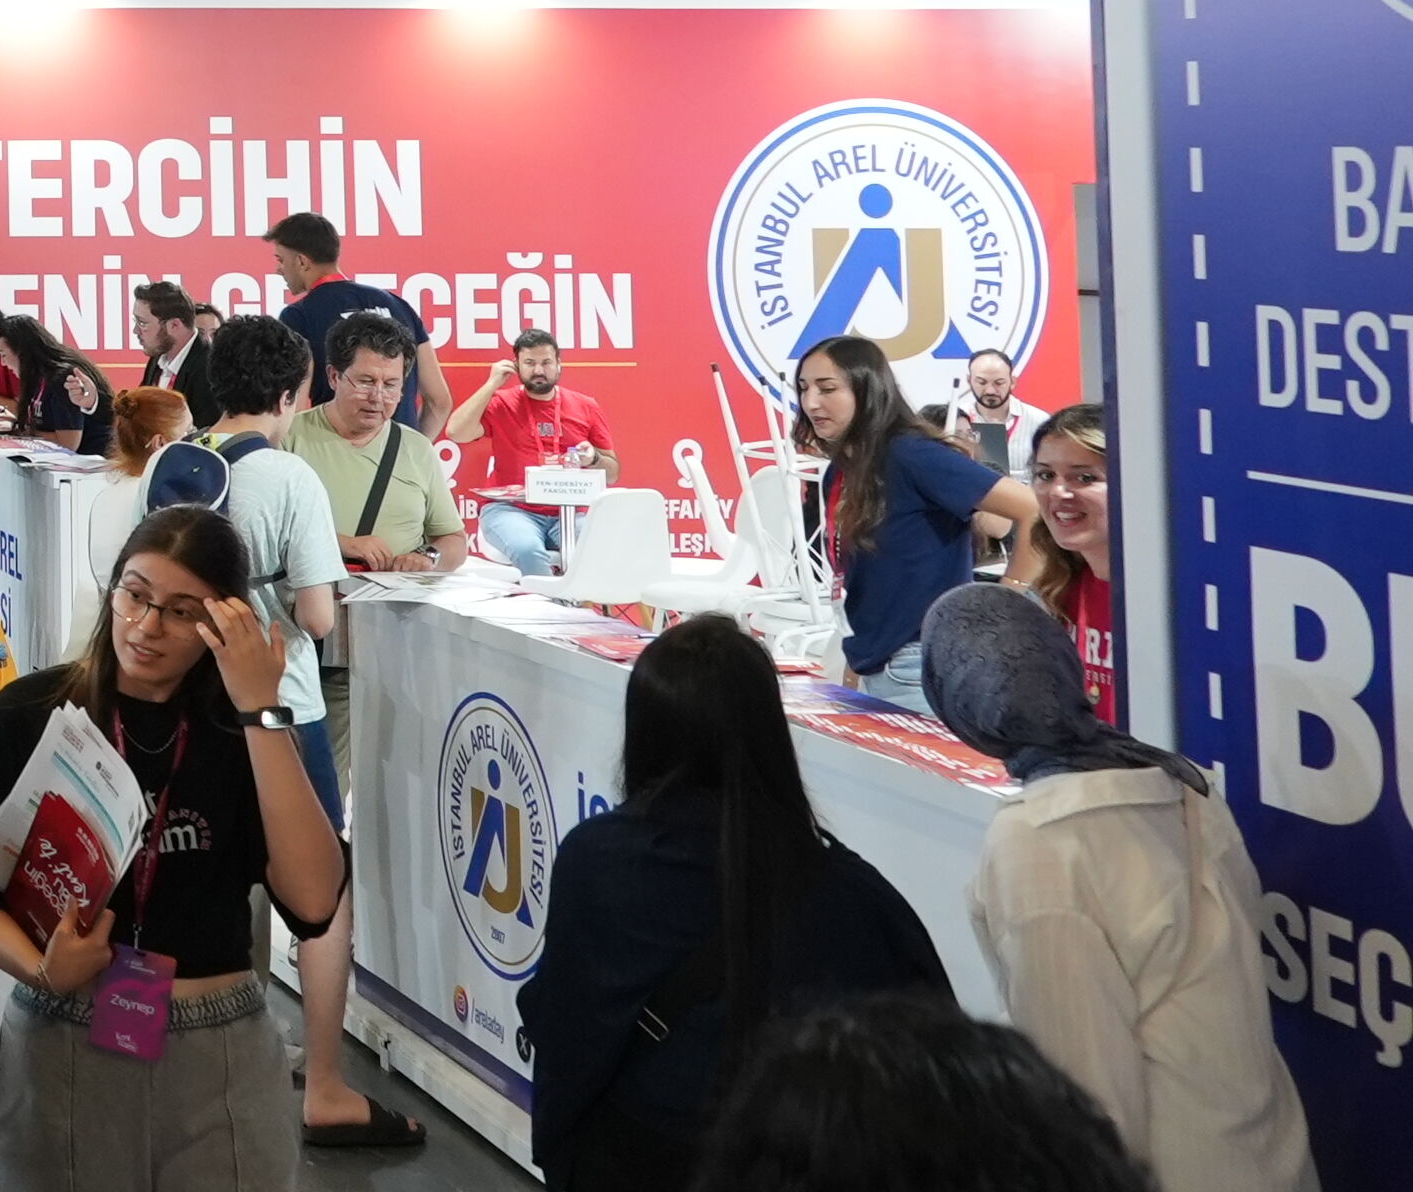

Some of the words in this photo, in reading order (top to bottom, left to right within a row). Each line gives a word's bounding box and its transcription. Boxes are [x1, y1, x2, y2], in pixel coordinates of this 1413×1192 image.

[811, 143, 886, 189] AREL
[753, 181, 814, 332] İSTANBUL
[894, 140, 1011, 333] ÜNİVERSİTESİ
[452, 744, 472, 861] İSTANBUL
[472, 723, 498, 753] AREL
[500, 728, 545, 910] ÜNİVERSİTESİ
